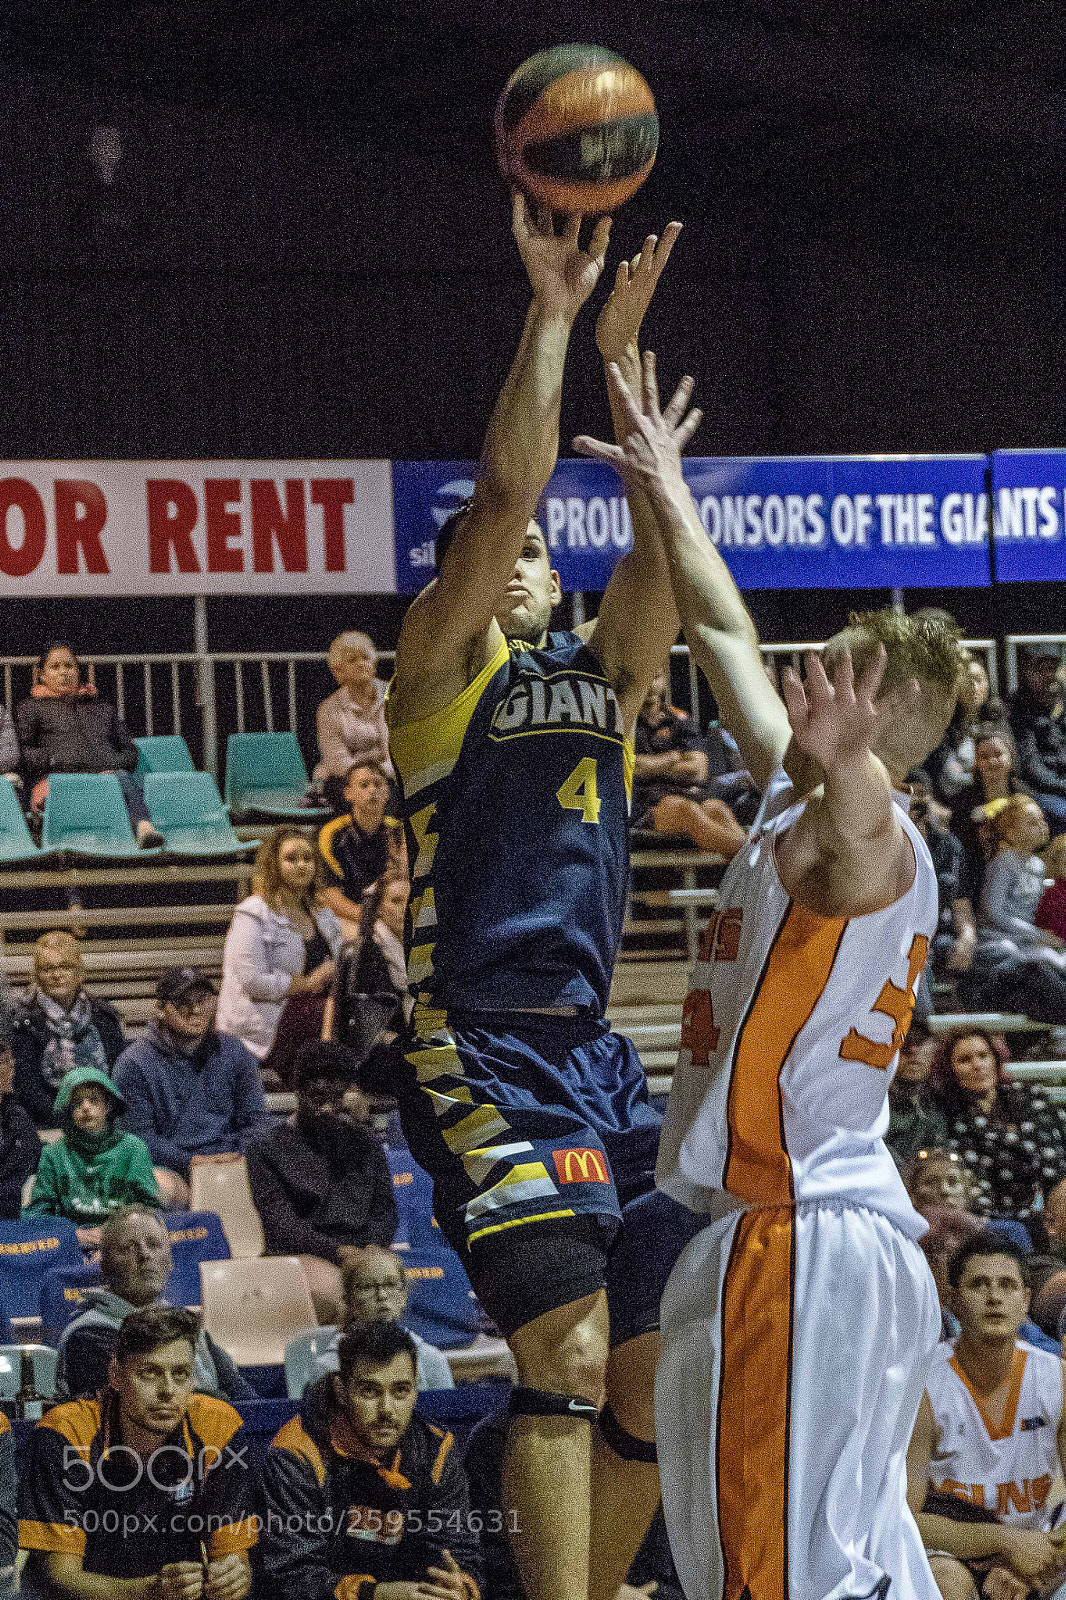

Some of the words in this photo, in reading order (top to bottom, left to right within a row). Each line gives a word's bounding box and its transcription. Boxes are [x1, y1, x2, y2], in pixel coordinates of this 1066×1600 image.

[0, 477, 111, 577] OR
[146, 478, 355, 574] RENT
[546, 496, 632, 548] PROU
[692, 494, 826, 546] ONSORS
[830, 493, 872, 546] OF
[875, 493, 936, 544] THE
[493, 679, 625, 733] GIANT
[556, 756, 602, 824] 4
